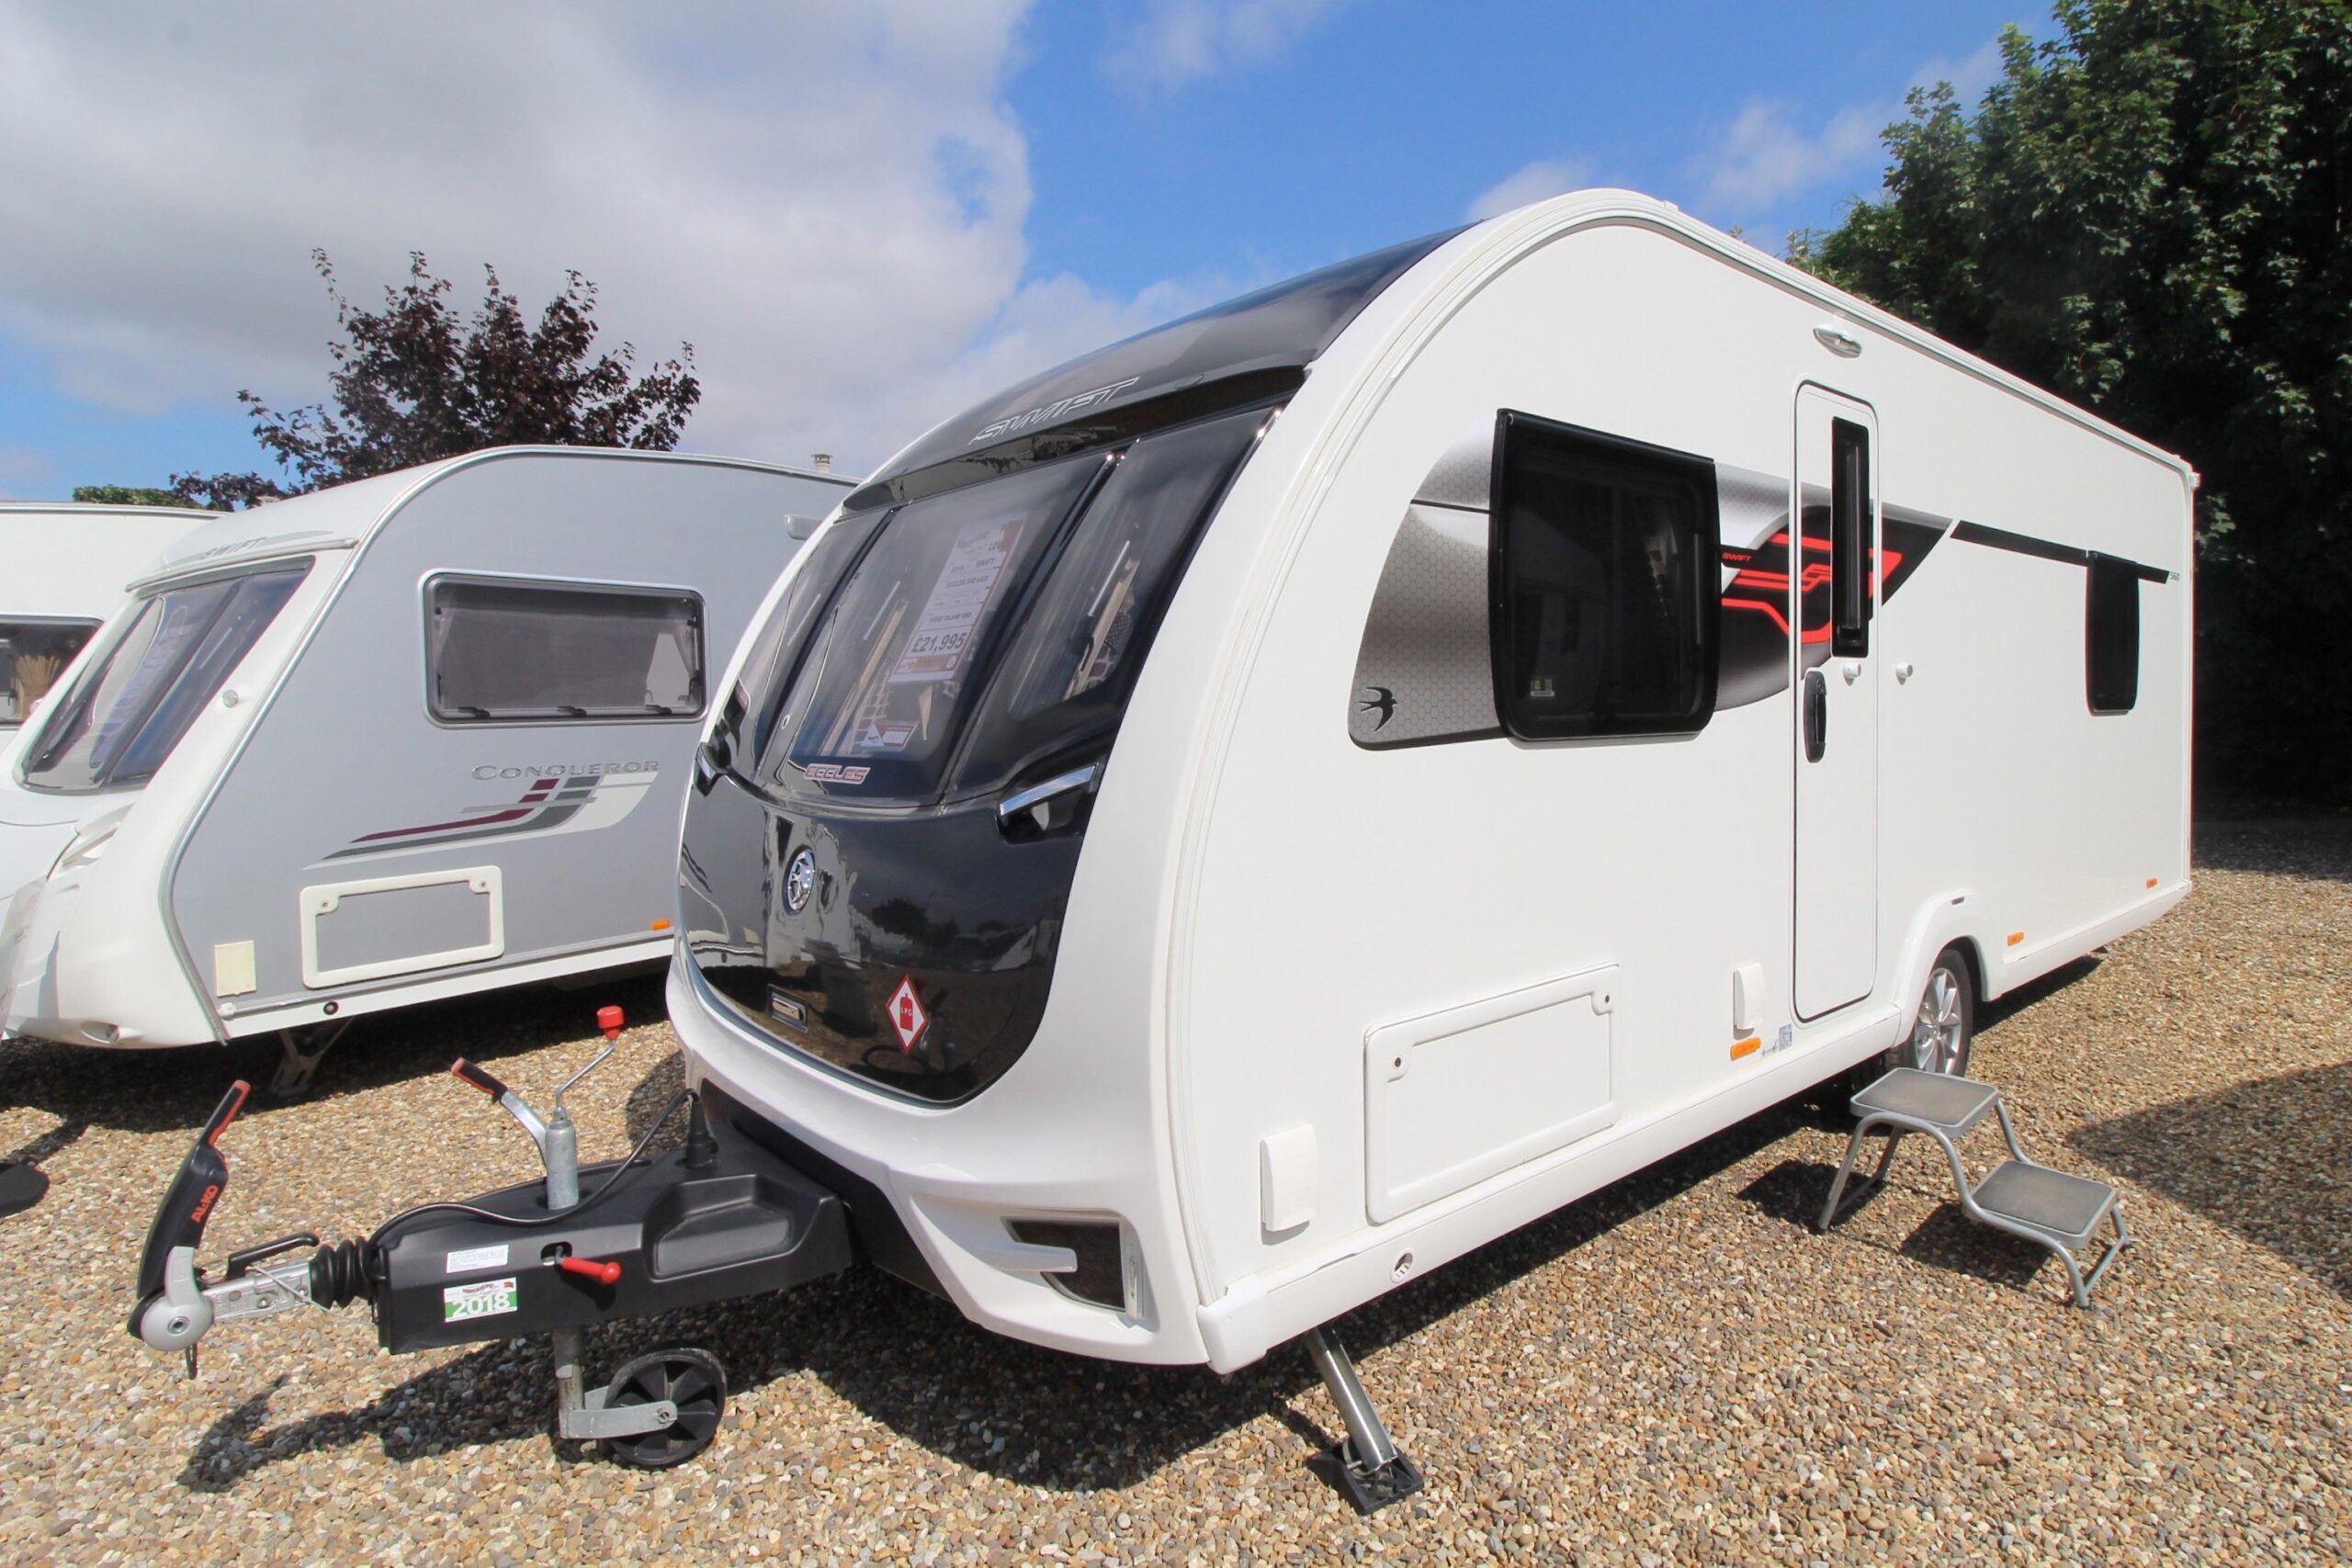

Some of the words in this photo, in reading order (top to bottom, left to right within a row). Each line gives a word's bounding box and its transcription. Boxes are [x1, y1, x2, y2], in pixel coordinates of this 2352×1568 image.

[1722, 552, 1753, 562] SWIFT
[910, 633, 967, 654] £21,995
[471, 761, 660, 781] CONQUEROR
[805, 763, 870, 784] ECCLES
[900, 1006, 912, 1016] LPG
[452, 1292, 511, 1318] 2018
